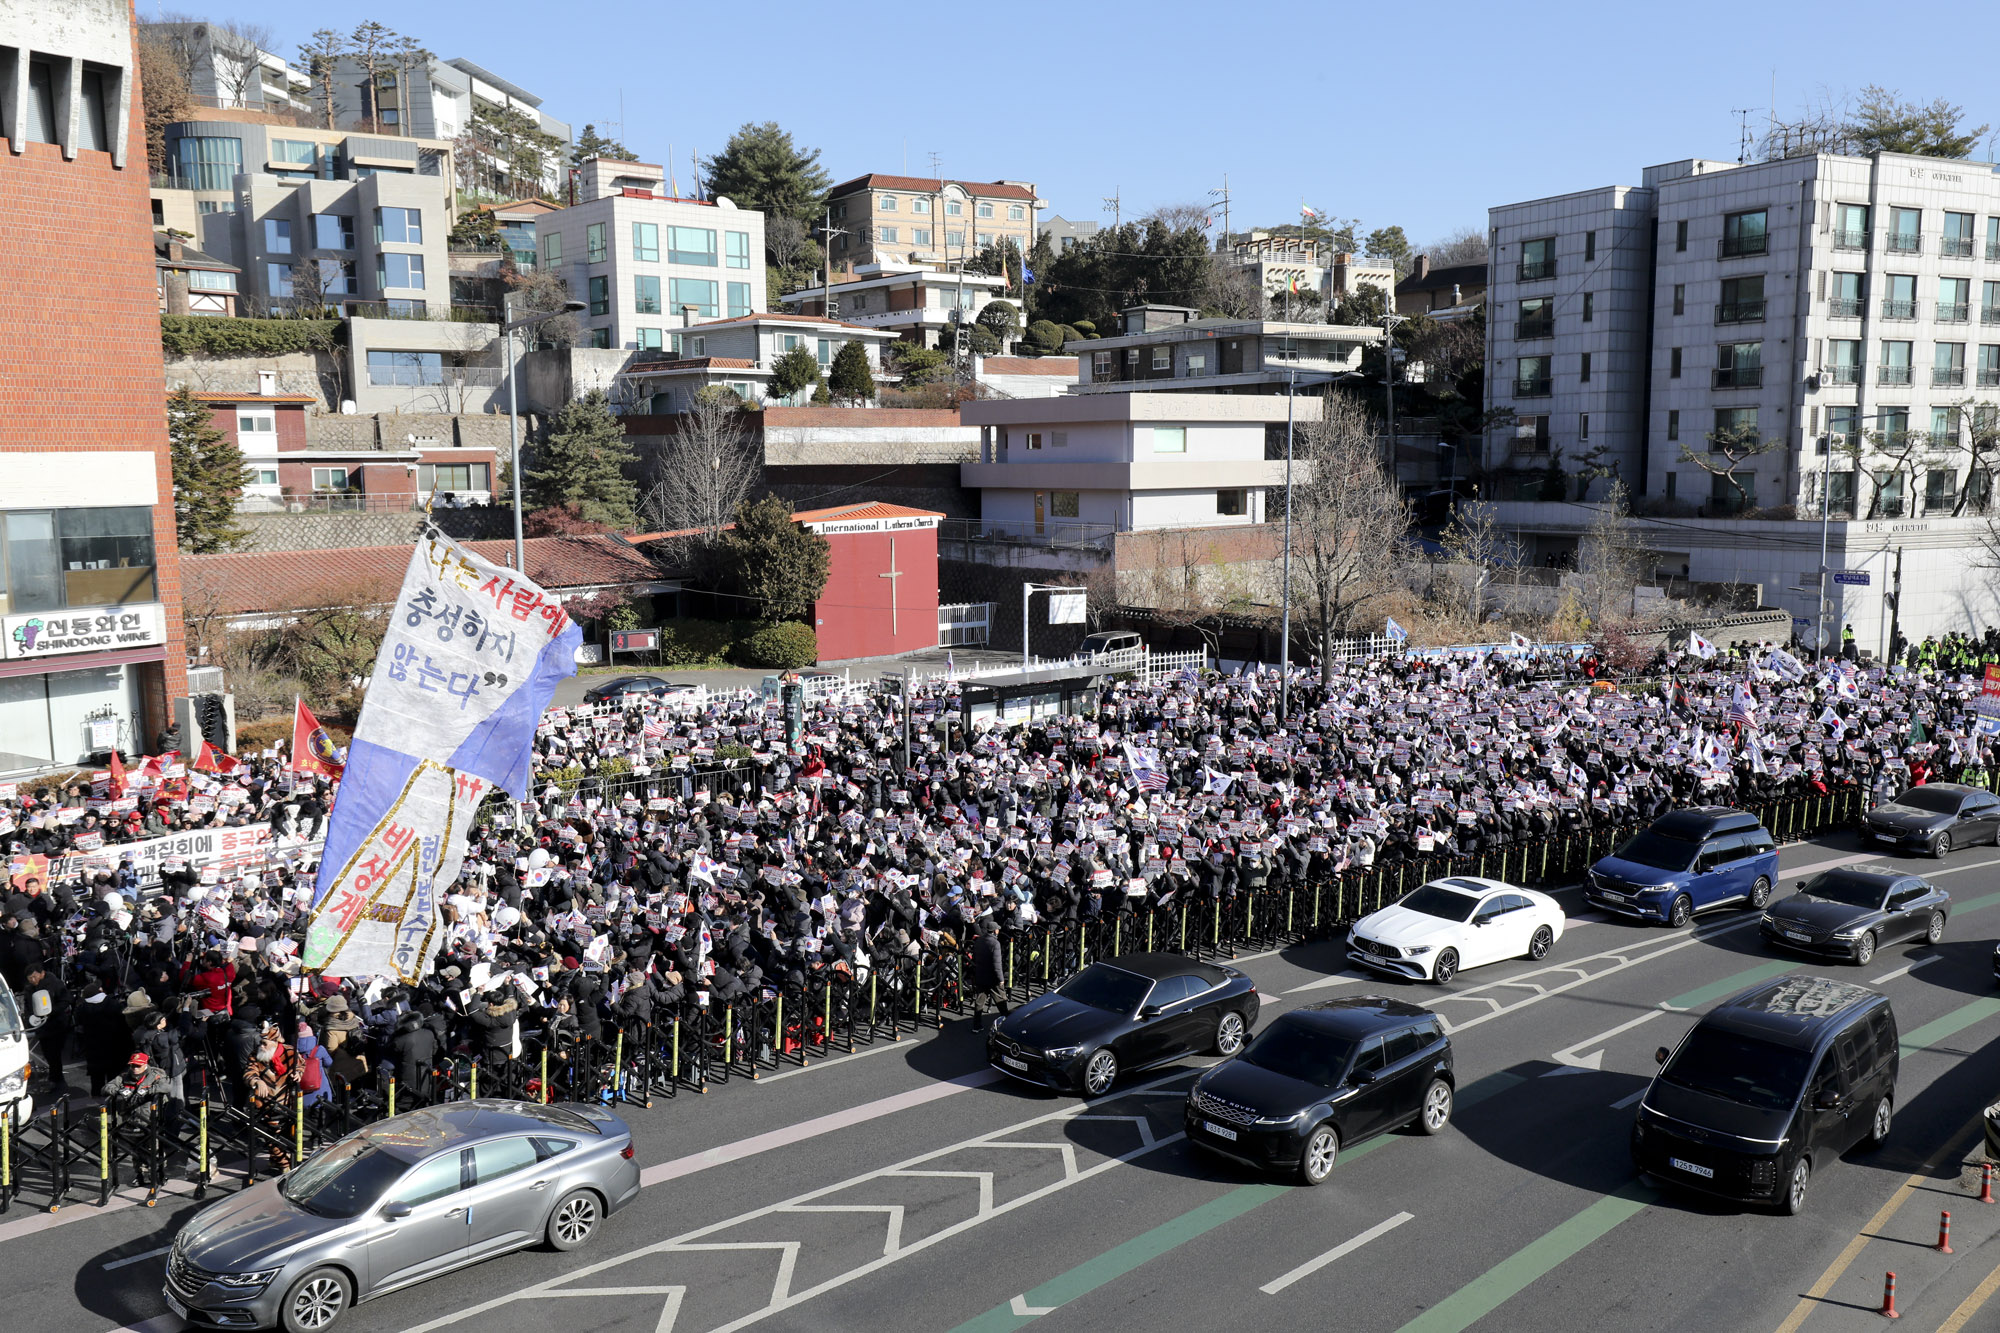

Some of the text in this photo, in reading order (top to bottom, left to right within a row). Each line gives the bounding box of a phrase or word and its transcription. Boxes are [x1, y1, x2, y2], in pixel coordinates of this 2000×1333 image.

[822, 517, 934, 533] International Lutheran Church
[479, 575, 569, 638] 사람에
[46, 613, 141, 637] 신동와인
[407, 587, 516, 664] 충성하지
[36, 631, 151, 651] SHINDONG WINE
